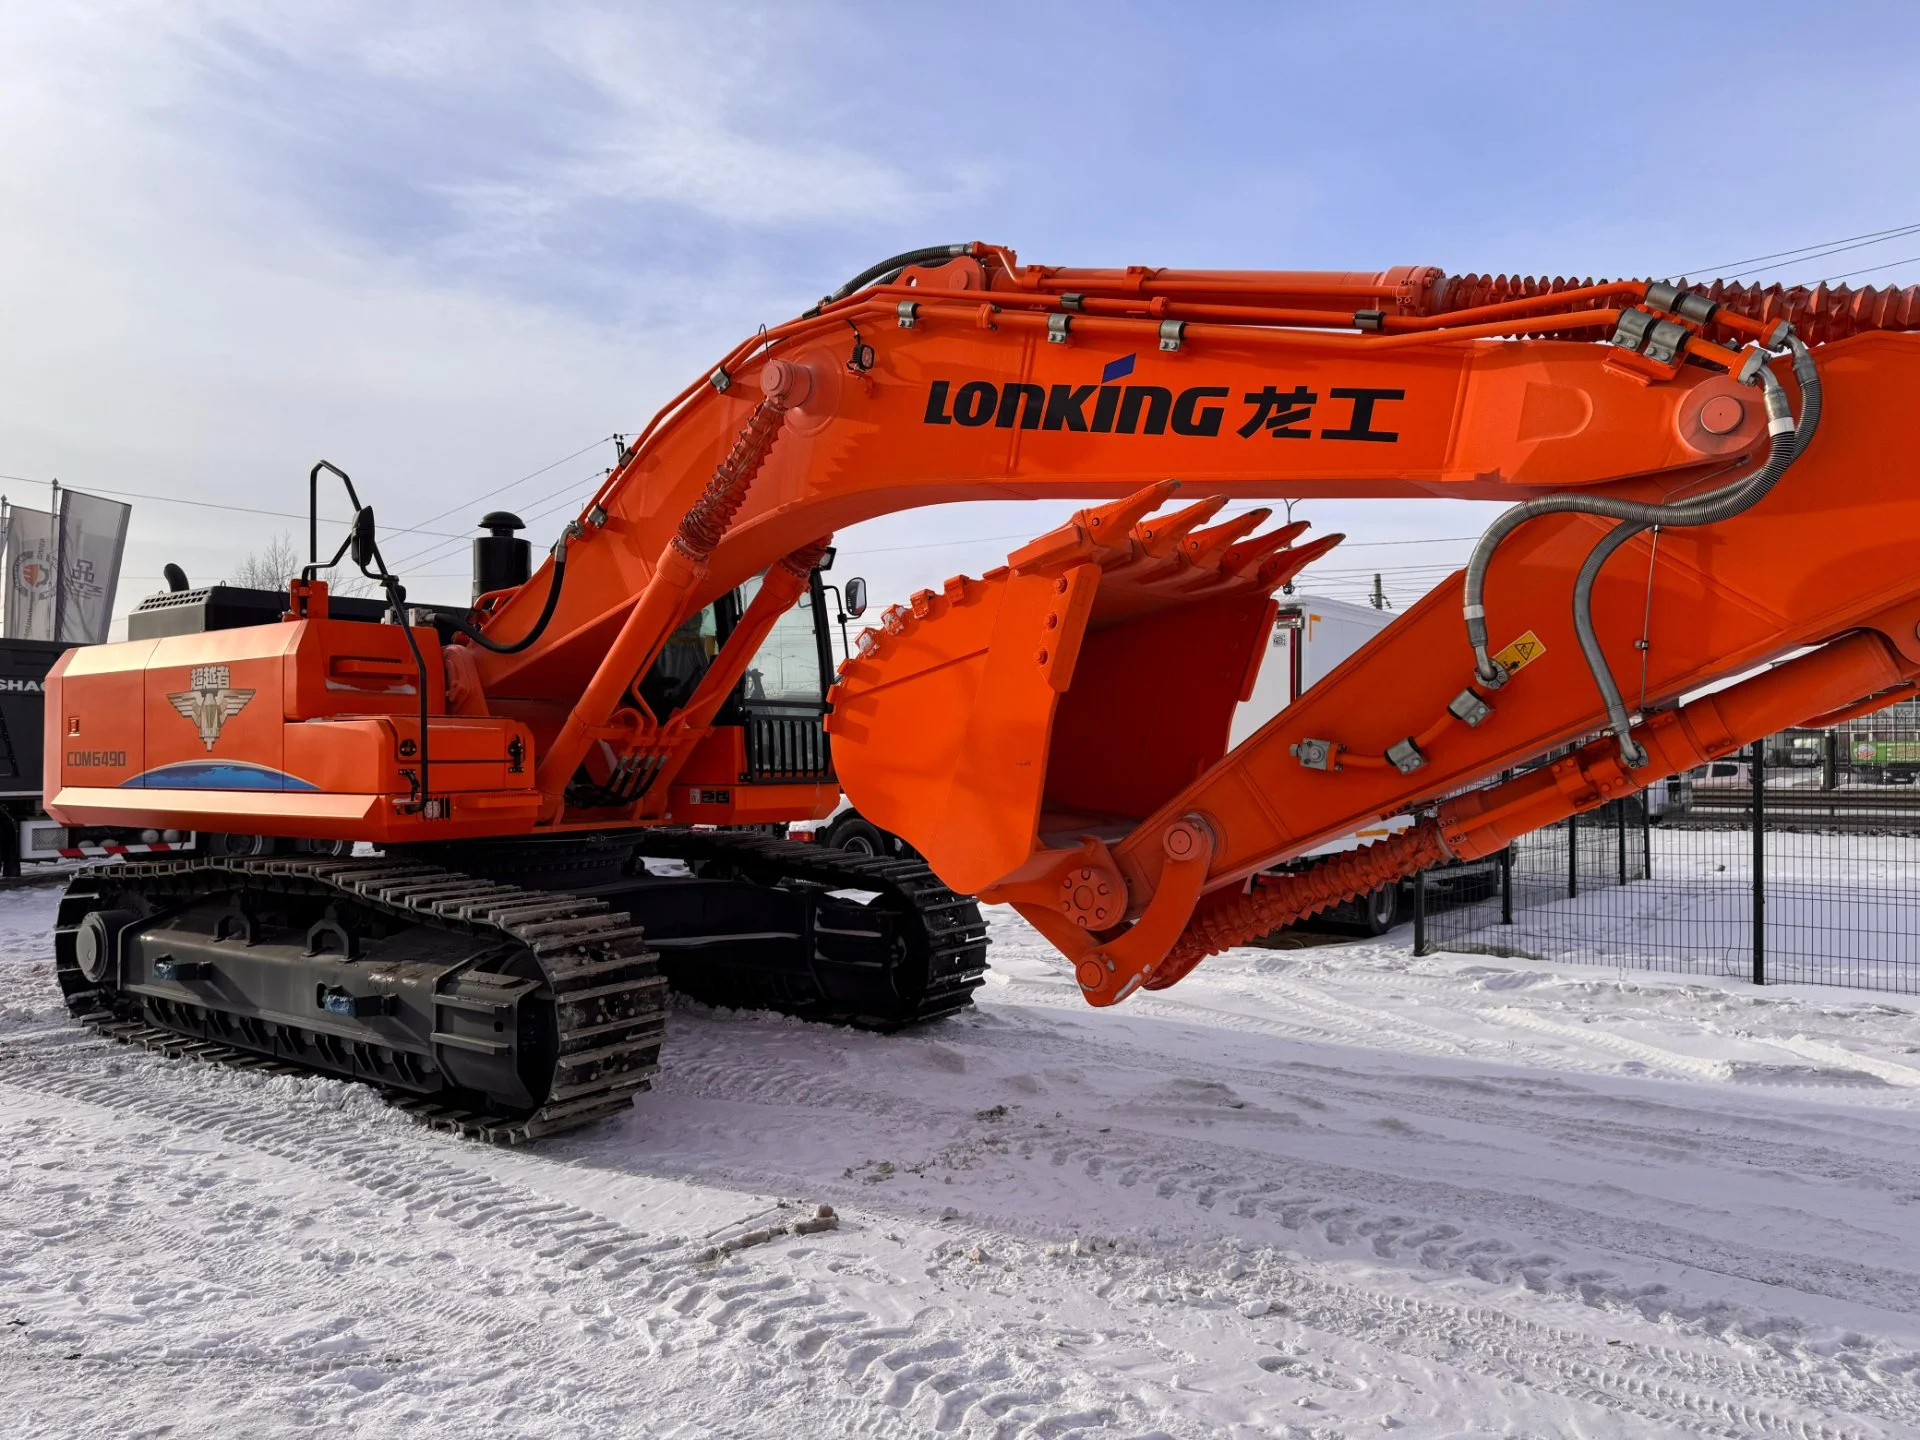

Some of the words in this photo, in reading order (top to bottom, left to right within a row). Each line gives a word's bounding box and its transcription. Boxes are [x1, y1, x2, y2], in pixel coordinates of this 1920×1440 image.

[1236, 386, 1405, 443] 龙工
[0, 678, 45, 692] SHA
[190, 665, 231, 691] 超越者
[67, 751, 127, 767] CDM6490
